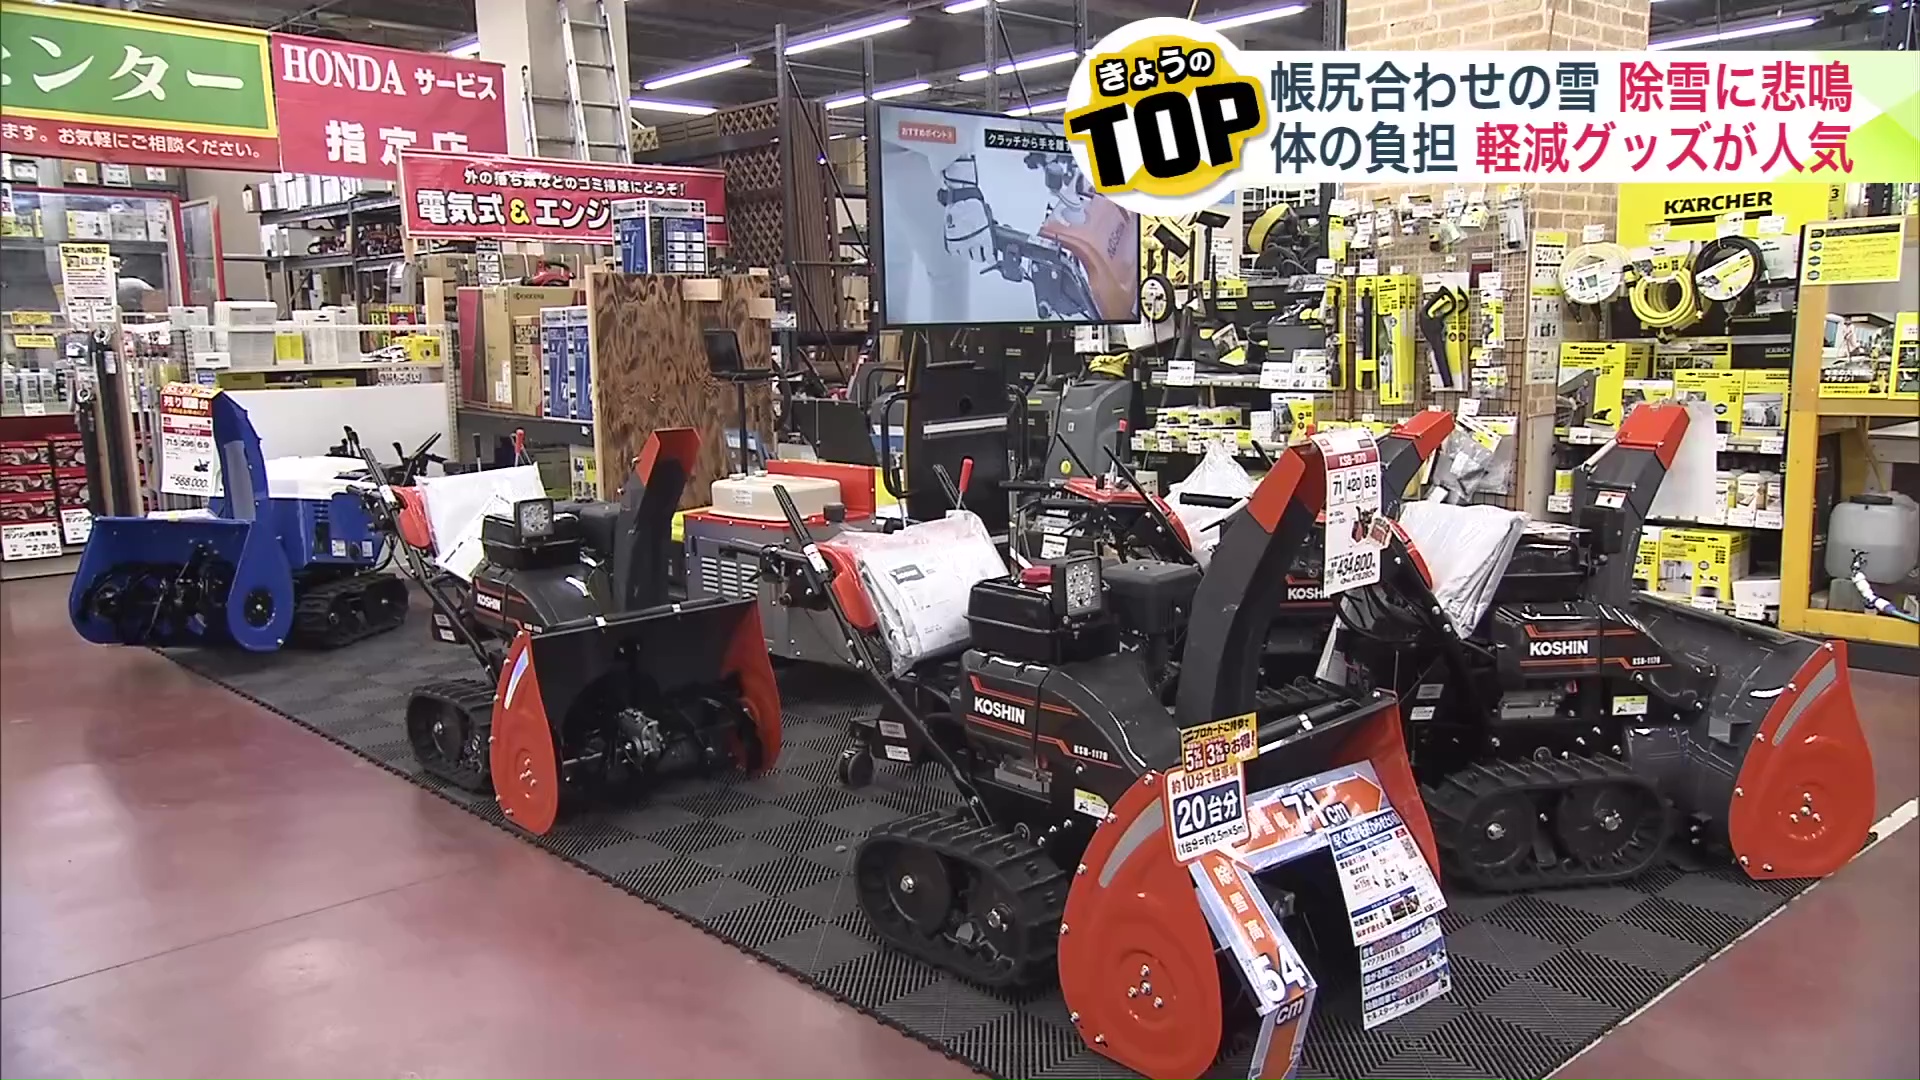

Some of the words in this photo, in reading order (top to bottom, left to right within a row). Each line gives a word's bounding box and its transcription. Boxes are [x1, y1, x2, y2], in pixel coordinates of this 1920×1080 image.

[1, 36, 244, 101] ンター
[280, 43, 406, 96] HONDA
[414, 67, 497, 100] サービス
[1664, 191, 1773, 216] KÄRCHER
[1332, 480, 1343, 496] 71
[1364, 474, 1377, 489] 8.6
[477, 593, 501, 611] KOSHIN
[1287, 586, 1331, 600] KOSH
[1530, 640, 1588, 656] KOSHIN
[974, 696, 1026, 725] KOSHIN
[1176, 789, 1239, 836] 20台分
[1281, 789, 1328, 834] 71
[1326, 801, 1350, 826] cm
[1251, 944, 1305, 1002] 54
[1276, 997, 1305, 1025] cm
